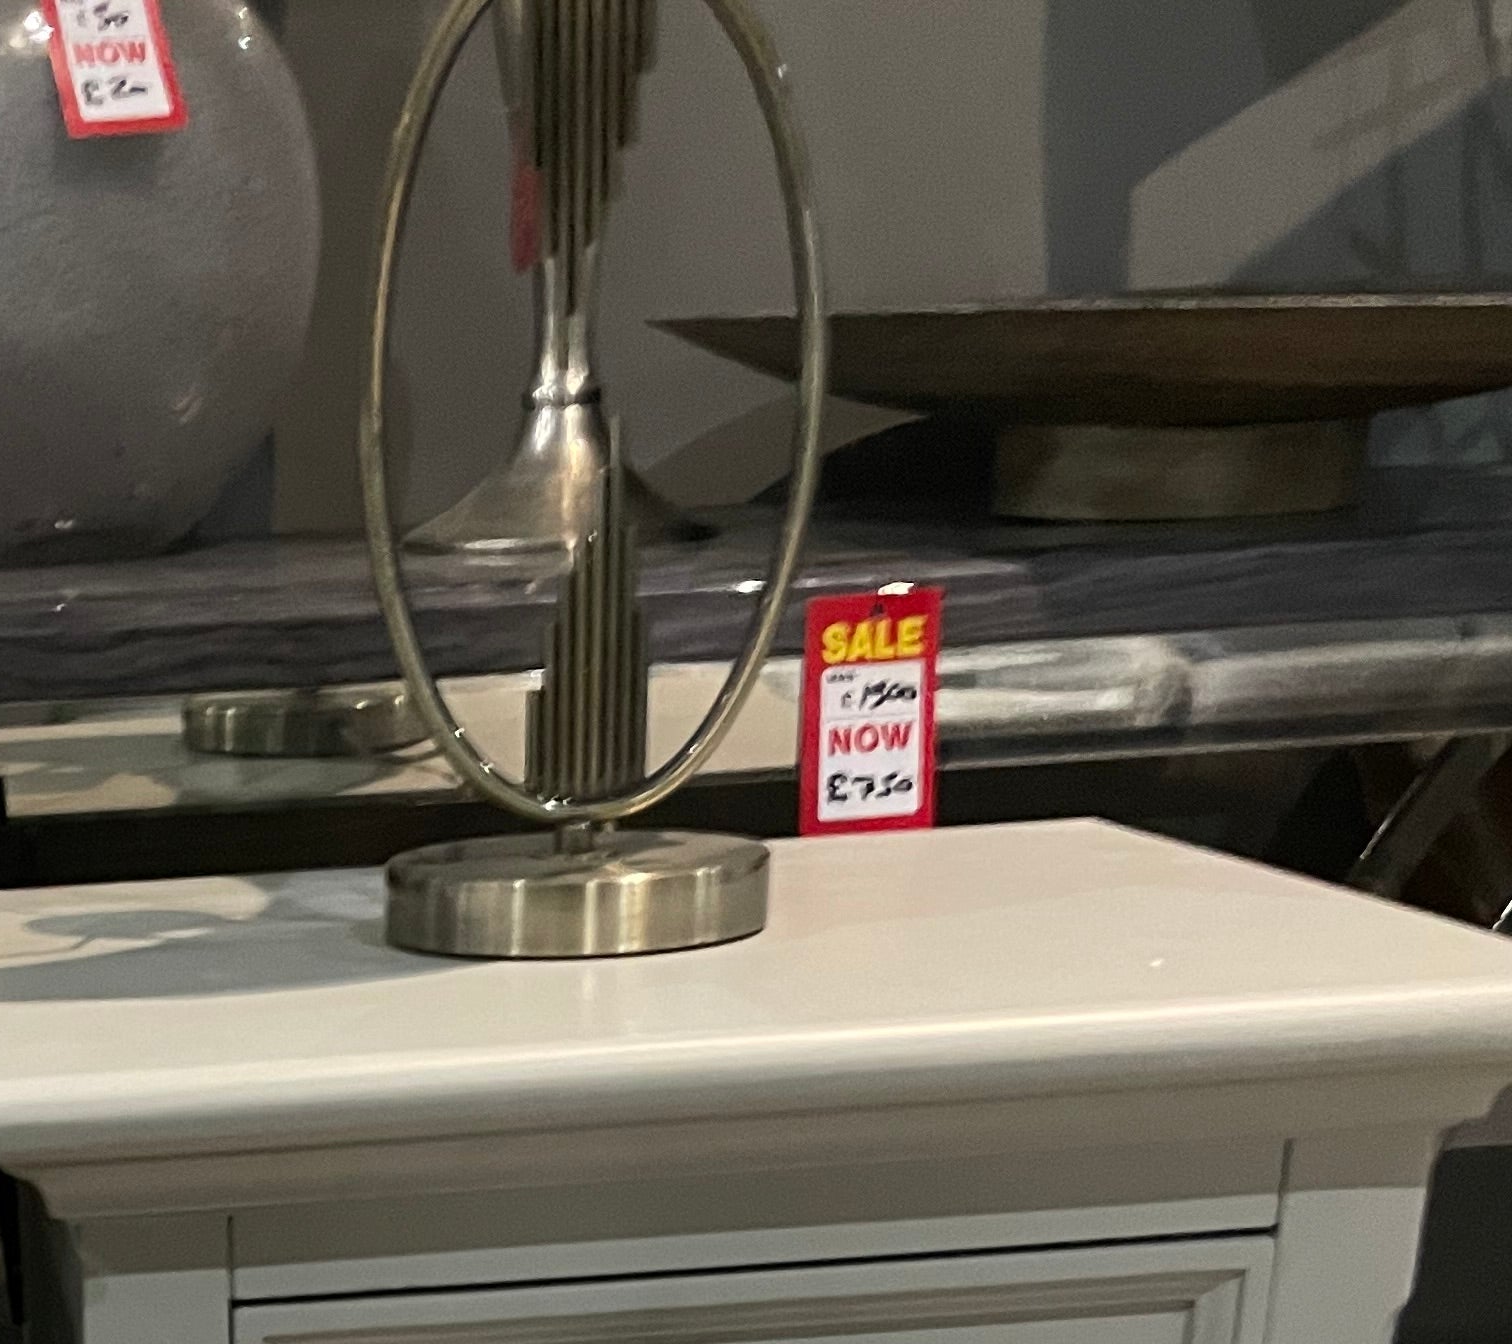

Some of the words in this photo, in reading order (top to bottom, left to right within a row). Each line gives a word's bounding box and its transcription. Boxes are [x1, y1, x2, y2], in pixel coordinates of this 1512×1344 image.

[71, 37, 148, 66] NOW
[821, 614, 929, 665] SALE
[827, 720, 913, 757] NOW
